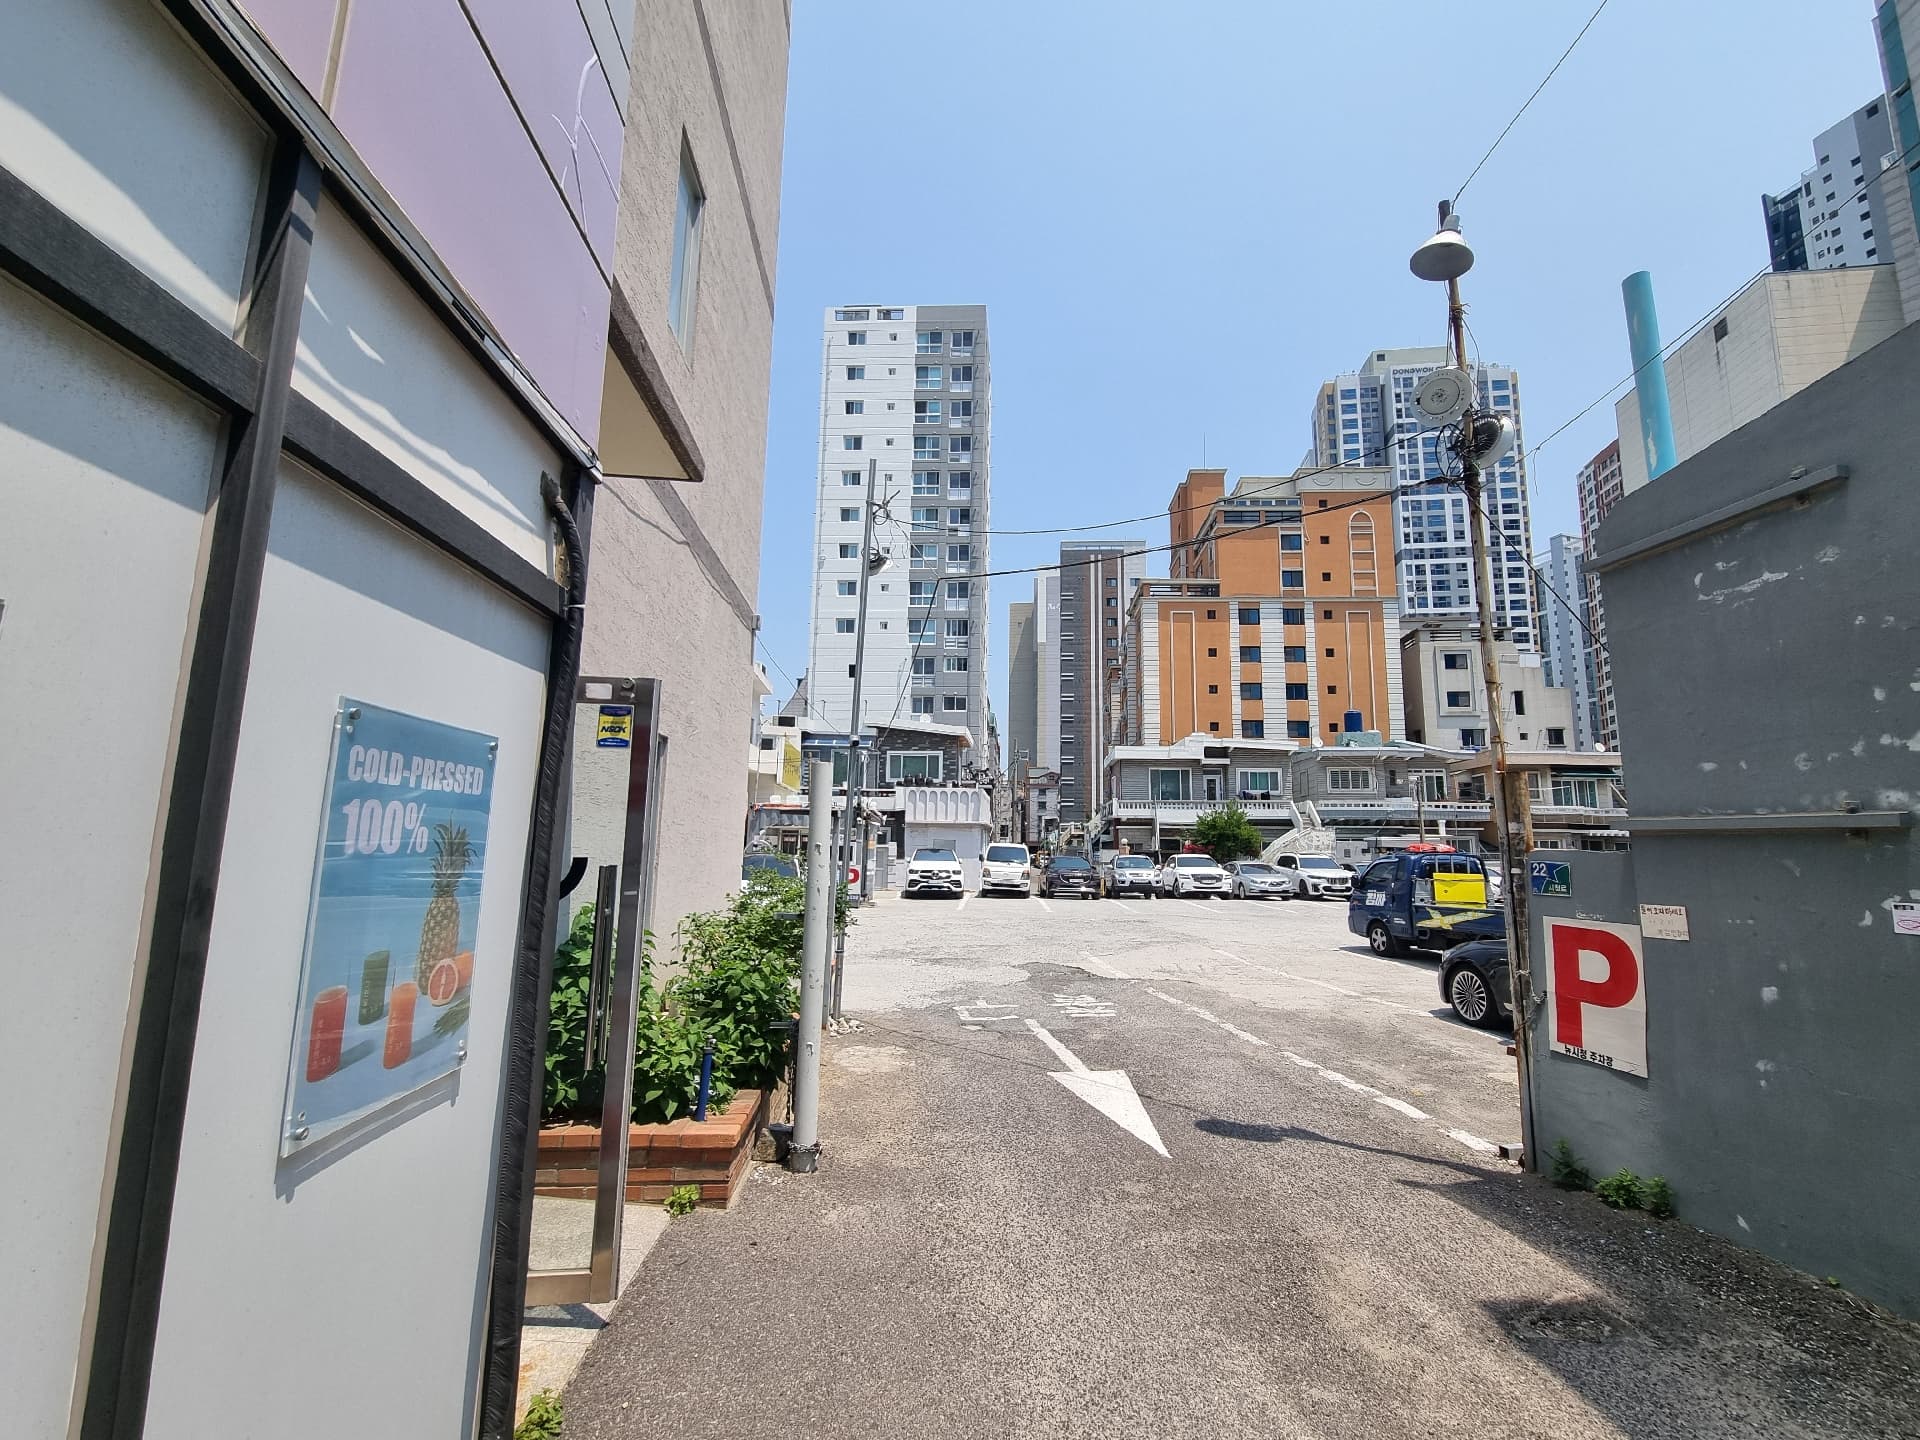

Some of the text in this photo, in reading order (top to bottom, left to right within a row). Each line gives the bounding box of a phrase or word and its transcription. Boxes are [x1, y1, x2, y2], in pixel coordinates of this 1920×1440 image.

[1392, 366, 1434, 375] DONGWON
[348, 744, 484, 795] COLD-PRESSED
[342, 798, 429, 854] 100%
[1532, 863, 1548, 877] 22
[1552, 924, 1638, 1048] P
[1589, 1050, 1614, 1067] 주차장
